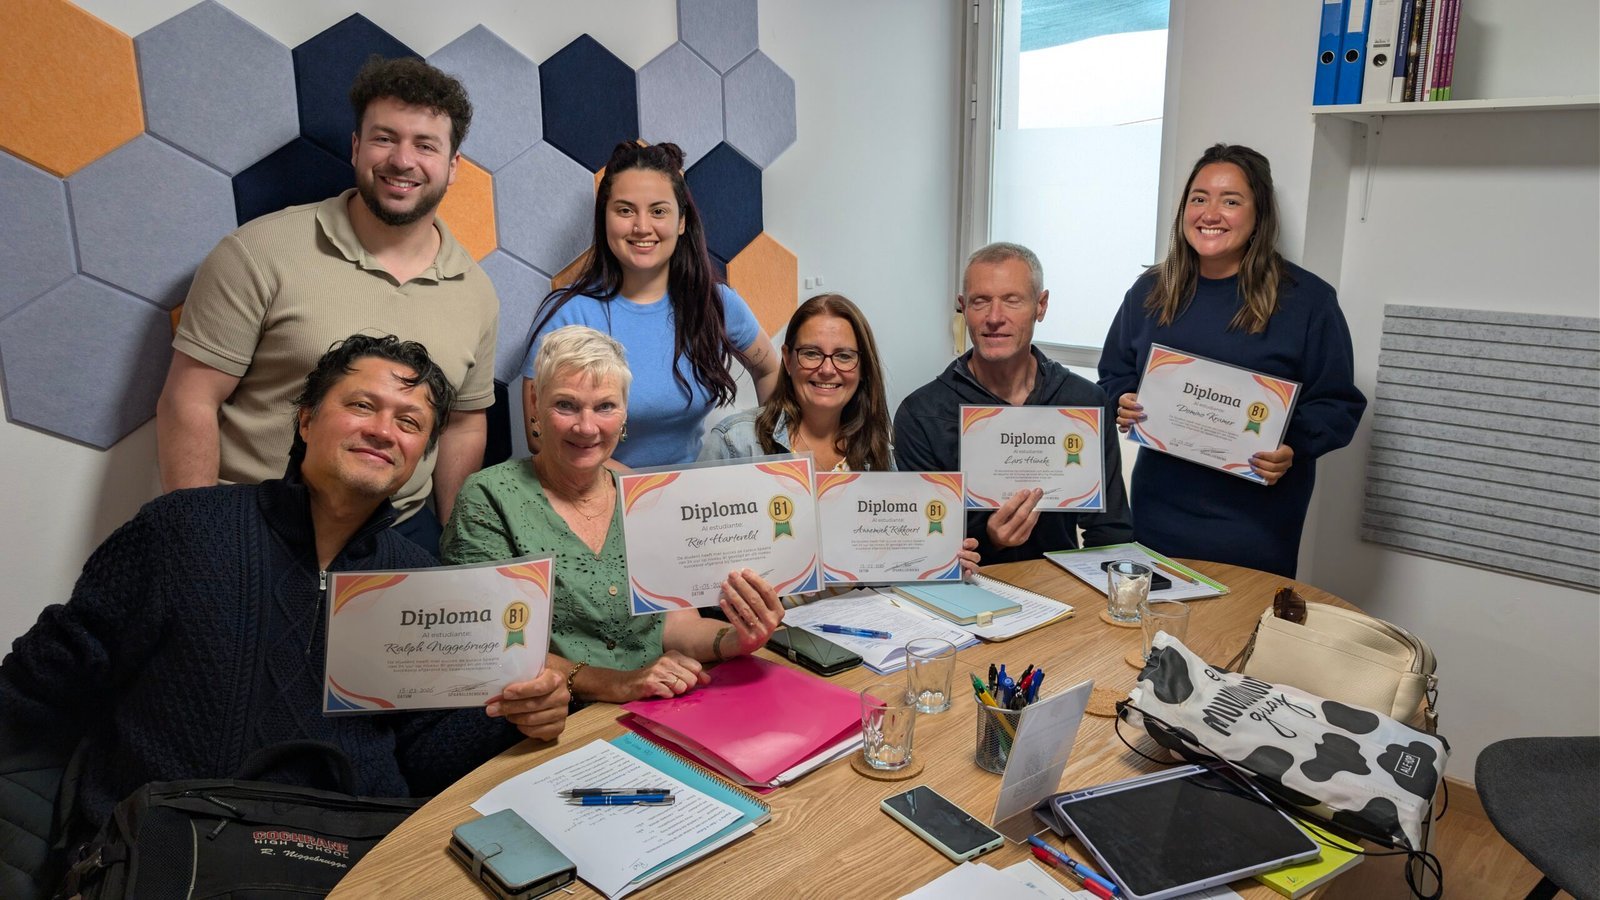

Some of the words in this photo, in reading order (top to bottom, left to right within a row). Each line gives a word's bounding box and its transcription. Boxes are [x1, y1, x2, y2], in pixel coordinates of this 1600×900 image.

[1183, 382, 1241, 408] Diploma
[1252, 405, 1265, 418] B1
[1000, 432, 1056, 447] Diploma
[1068, 438, 1079, 449] B1
[681, 501, 758, 522] Diploma
[773, 502, 788, 516] B1
[857, 500, 918, 515] Diploma
[930, 505, 942, 516] B1
[400, 607, 492, 629] Diploma
[509, 606, 524, 624] B1
[384, 640, 423, 655] Ralph
[427, 640, 500, 655] Niggebrugge
[253, 831, 350, 854] COCHRANE
[297, 842, 350, 859] SCHOOL
[283, 850, 348, 868] Niggebrugge
